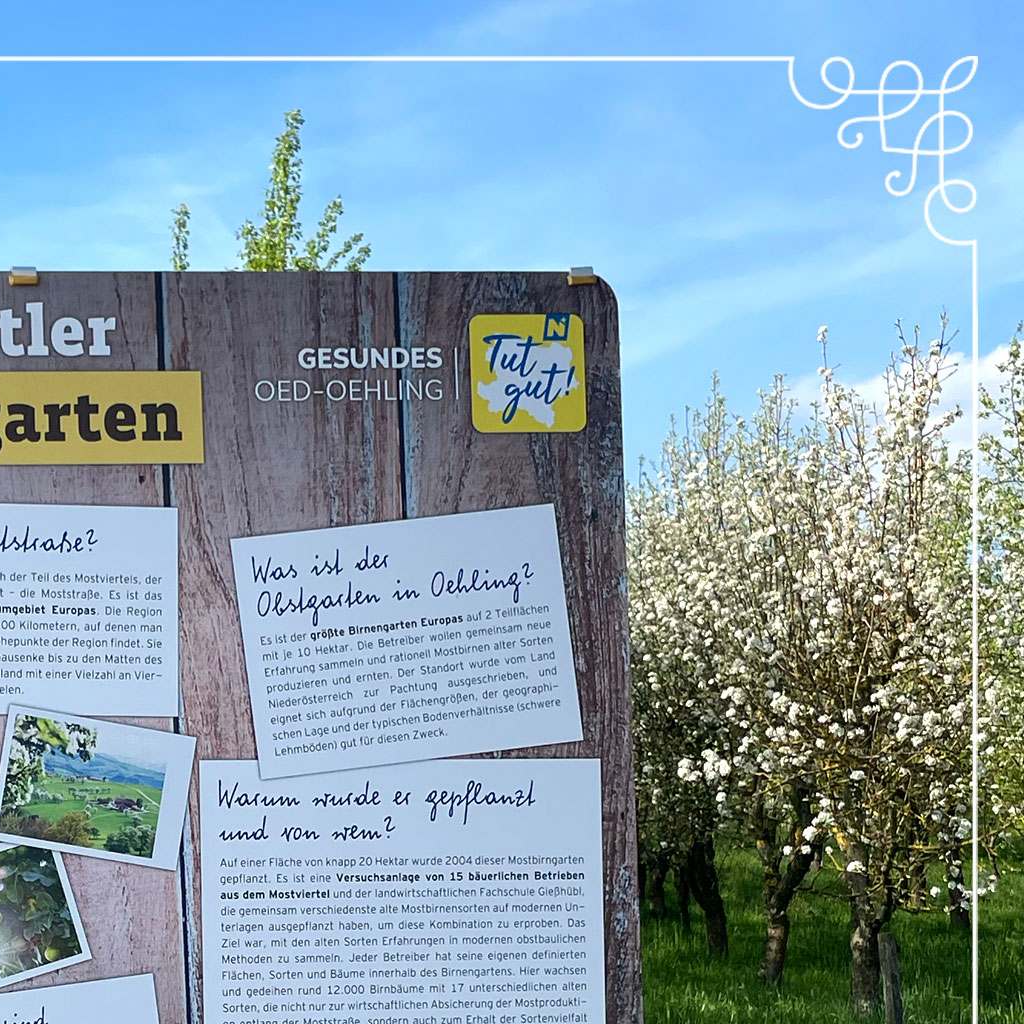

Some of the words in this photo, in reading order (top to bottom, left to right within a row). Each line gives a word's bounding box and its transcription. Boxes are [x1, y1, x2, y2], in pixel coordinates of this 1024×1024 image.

[297, 347, 443, 370] GESUNDES
[483, 334, 543, 377] Tut
[254, 379, 443, 402] OED-OEHLING
[503, 364, 576, 424] gut!
[251, 556, 298, 584] Was
[310, 548, 344, 577] ist
[354, 545, 389, 571] der
[257, 582, 381, 627] Obstgarten
[392, 579, 420, 601] in
[431, 562, 534, 604] Oehling?
[52, 605, 99, 617] Europas.
[105, 606, 122, 616] Die
[127, 606, 162, 619] Region
[260, 636, 272, 646] Es
[275, 633, 287, 644] ist
[290, 632, 307, 643] der
[310, 627, 345, 642] größte
[348, 620, 418, 636] Birnengarten
[420, 615, 464, 627] Europas
[466, 610, 482, 622] auf
[485, 610, 492, 620] 2
[495, 605, 549, 618] Teilflächen
[274, 740, 337, 757] Lehmböden)
[340, 738, 357, 751] gut
[359, 736, 374, 746] für
[377, 733, 410, 744] diesen
[412, 727, 448, 740] Zweck.
[218, 780, 301, 809] Warum
[311, 780, 383, 808] wurde
[392, 790, 411, 806] er
[424, 779, 536, 825] gepflanzt
[218, 816, 269, 842] und
[280, 826, 320, 841] von
[331, 815, 396, 841] wem?
[220, 873, 271, 886] gepflanzt.
[276, 873, 288, 883] Es
[293, 873, 305, 883] ist
[310, 873, 331, 883] eine
[336, 872, 420, 884] Versuchsanlage
[425, 874, 444, 882] von
[450, 871, 464, 882] 15
[468, 871, 529, 881] bäuerlichen
[534, 870, 585, 881] Betrieben
